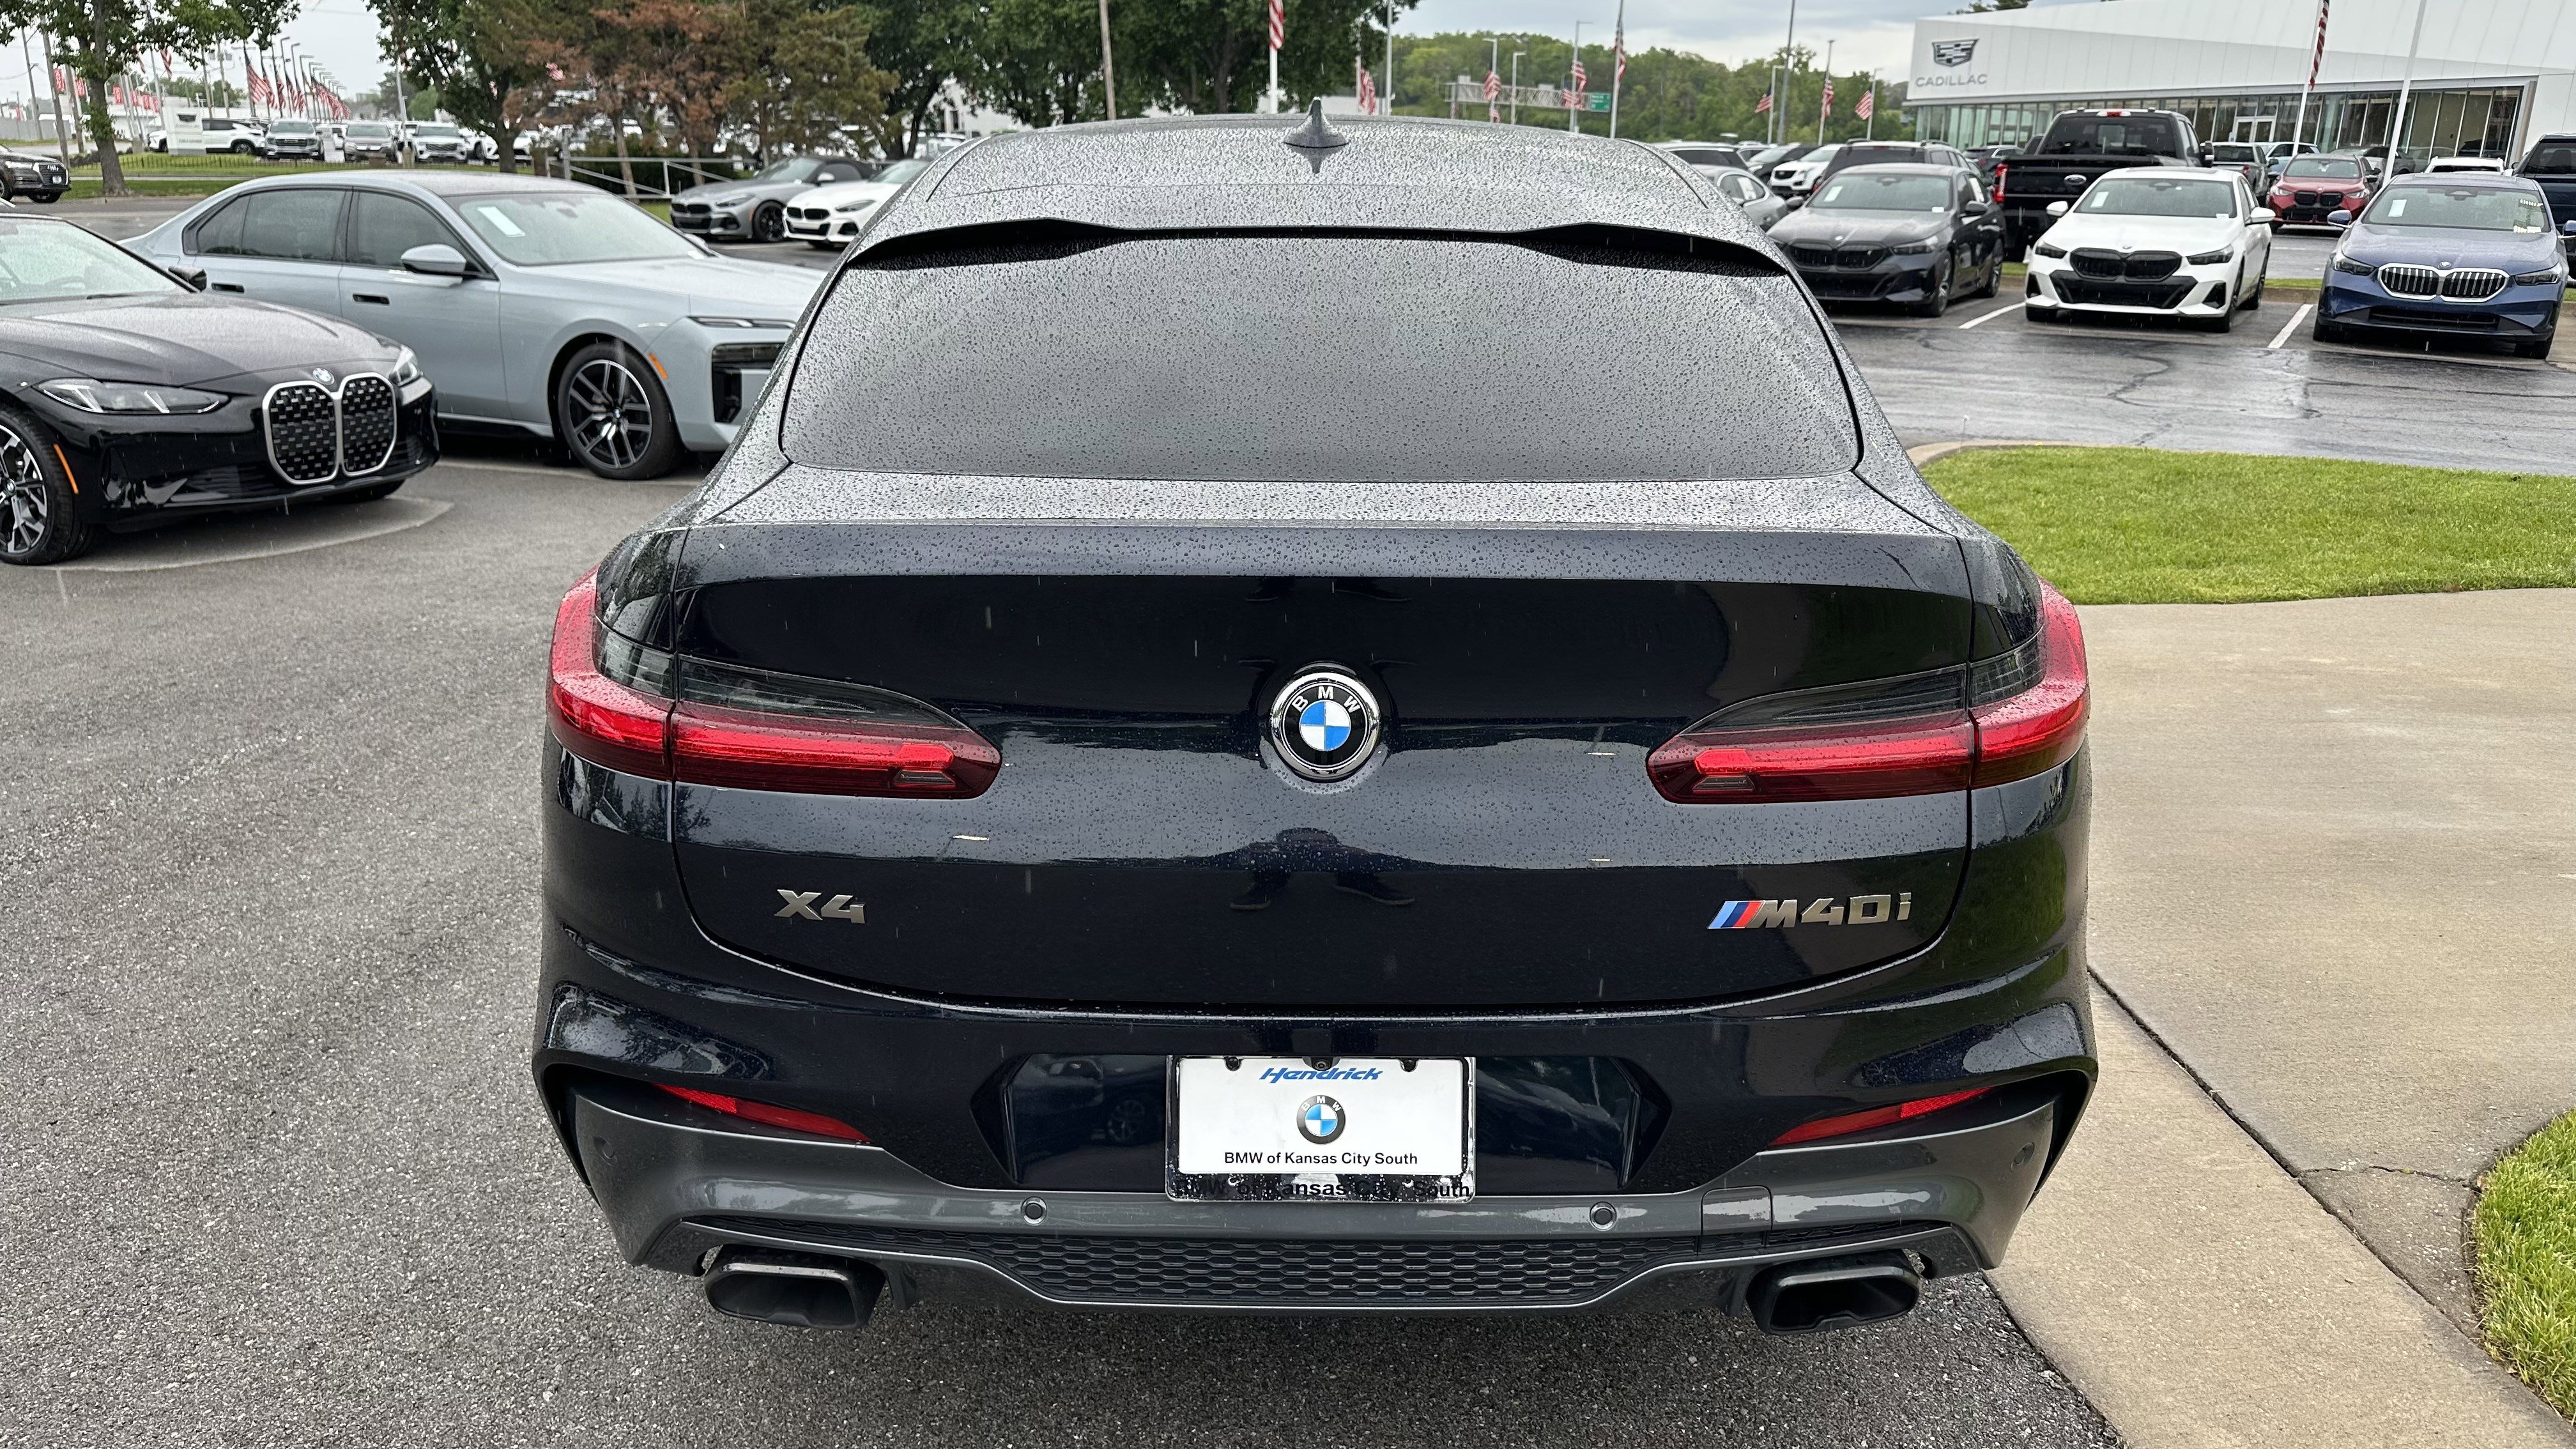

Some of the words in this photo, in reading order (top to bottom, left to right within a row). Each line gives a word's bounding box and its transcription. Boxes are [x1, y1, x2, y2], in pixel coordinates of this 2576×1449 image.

[1915, 73, 1988, 88] CADILLAC
[1291, 686, 1361, 713] BMW
[774, 889, 866, 924] X4
[1259, 1068, 1384, 1084] Hendrick
[1301, 1096, 1342, 1112] BMW
[1224, 1152, 1263, 1164] BMW
[1267, 1152, 1281, 1164] of
[1285, 1152, 1337, 1164] Kansas
[1341, 1152, 1370, 1167] City
[1374, 1153, 1418, 1165] South
[1414, 1180, 1470, 1197] South
